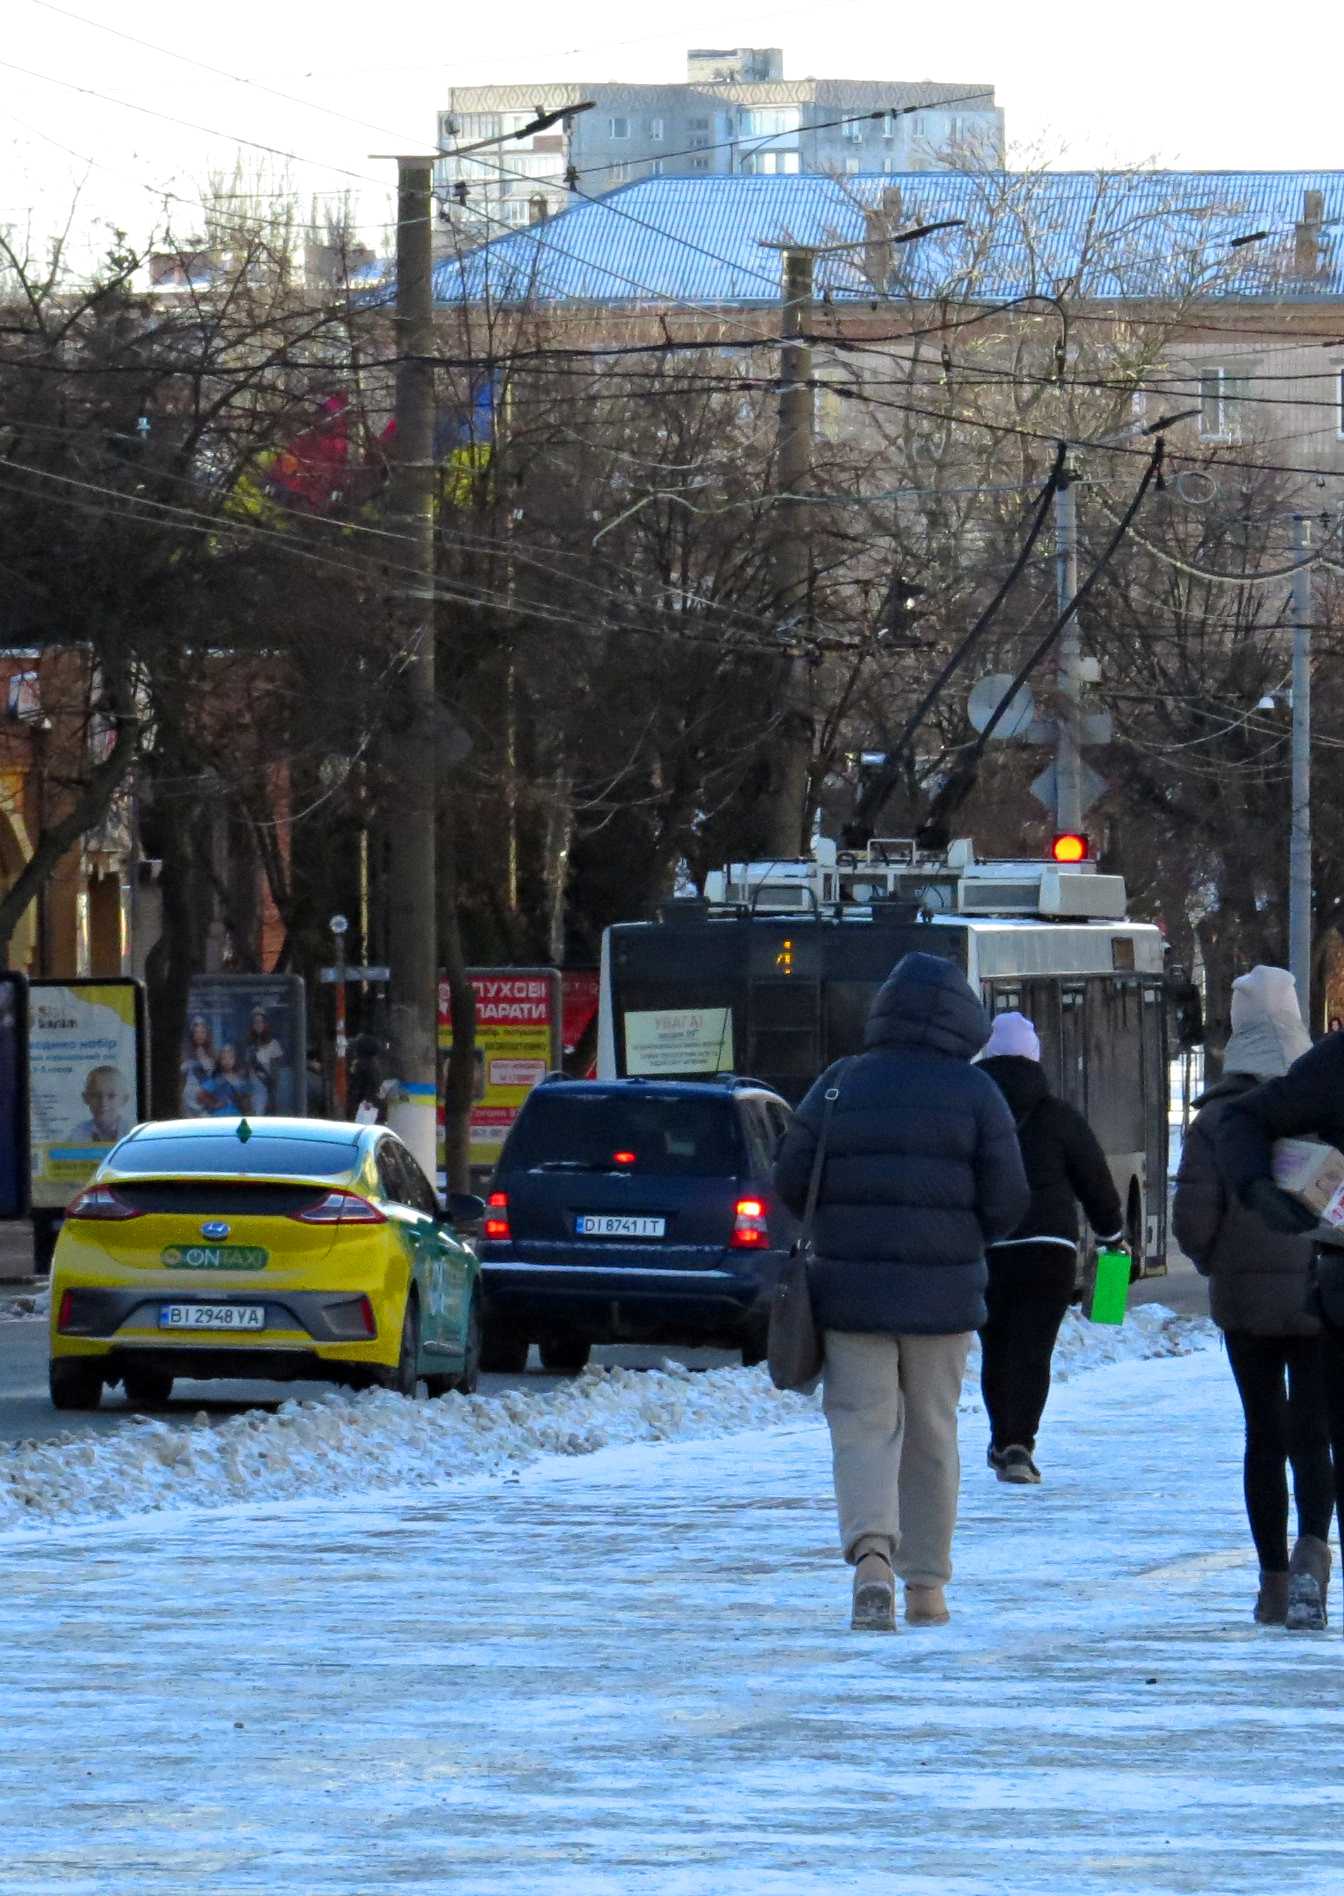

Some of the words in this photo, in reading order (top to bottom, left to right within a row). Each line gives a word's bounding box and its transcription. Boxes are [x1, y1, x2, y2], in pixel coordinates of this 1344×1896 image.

[585, 1218, 601, 1232] DI
[171, 1308, 189, 1323] BI
[195, 1308, 233, 1324] 2948
